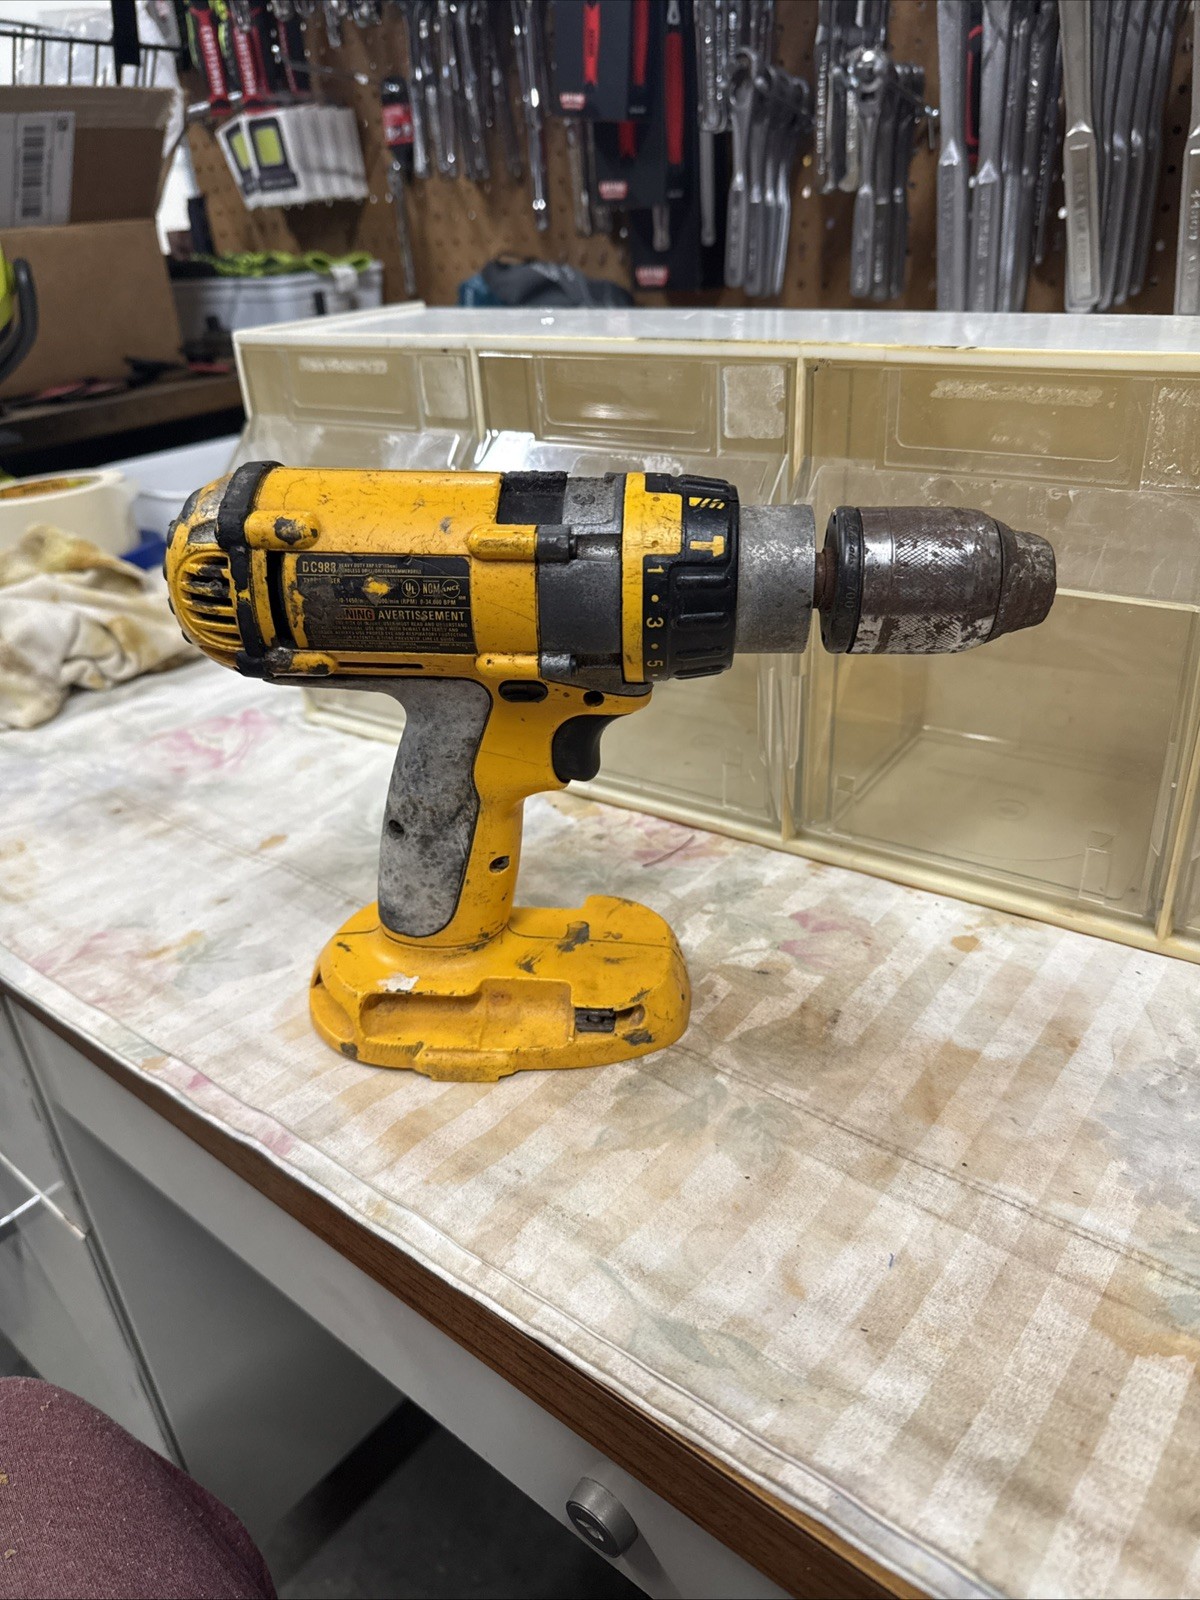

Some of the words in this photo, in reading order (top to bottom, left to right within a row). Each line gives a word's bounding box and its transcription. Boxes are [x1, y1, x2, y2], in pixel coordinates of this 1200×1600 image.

[647, 565, 664, 573] 1
[405, 582, 416, 595] UL
[378, 610, 464, 621] AVERTISSEMENT
[646, 617, 664, 628] 3
